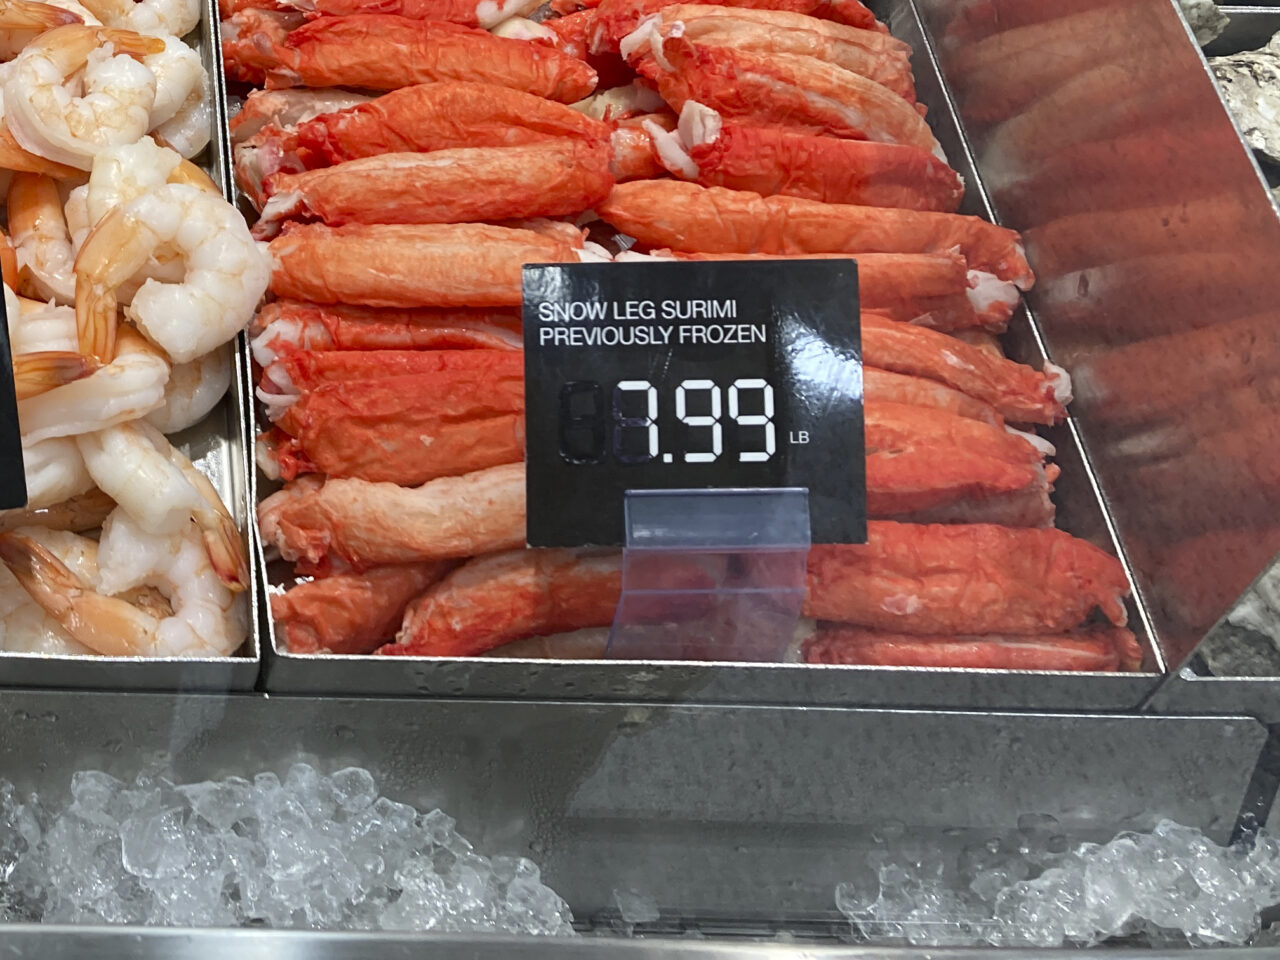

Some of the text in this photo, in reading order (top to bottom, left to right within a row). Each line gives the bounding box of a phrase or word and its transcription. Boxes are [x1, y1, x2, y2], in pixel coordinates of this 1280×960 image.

[538, 299, 737, 321] SNOW LEG SURIMI
[539, 324, 766, 346] PREVIOUSLY FROZEN
[617, 378, 809, 463] 7.99 LB
